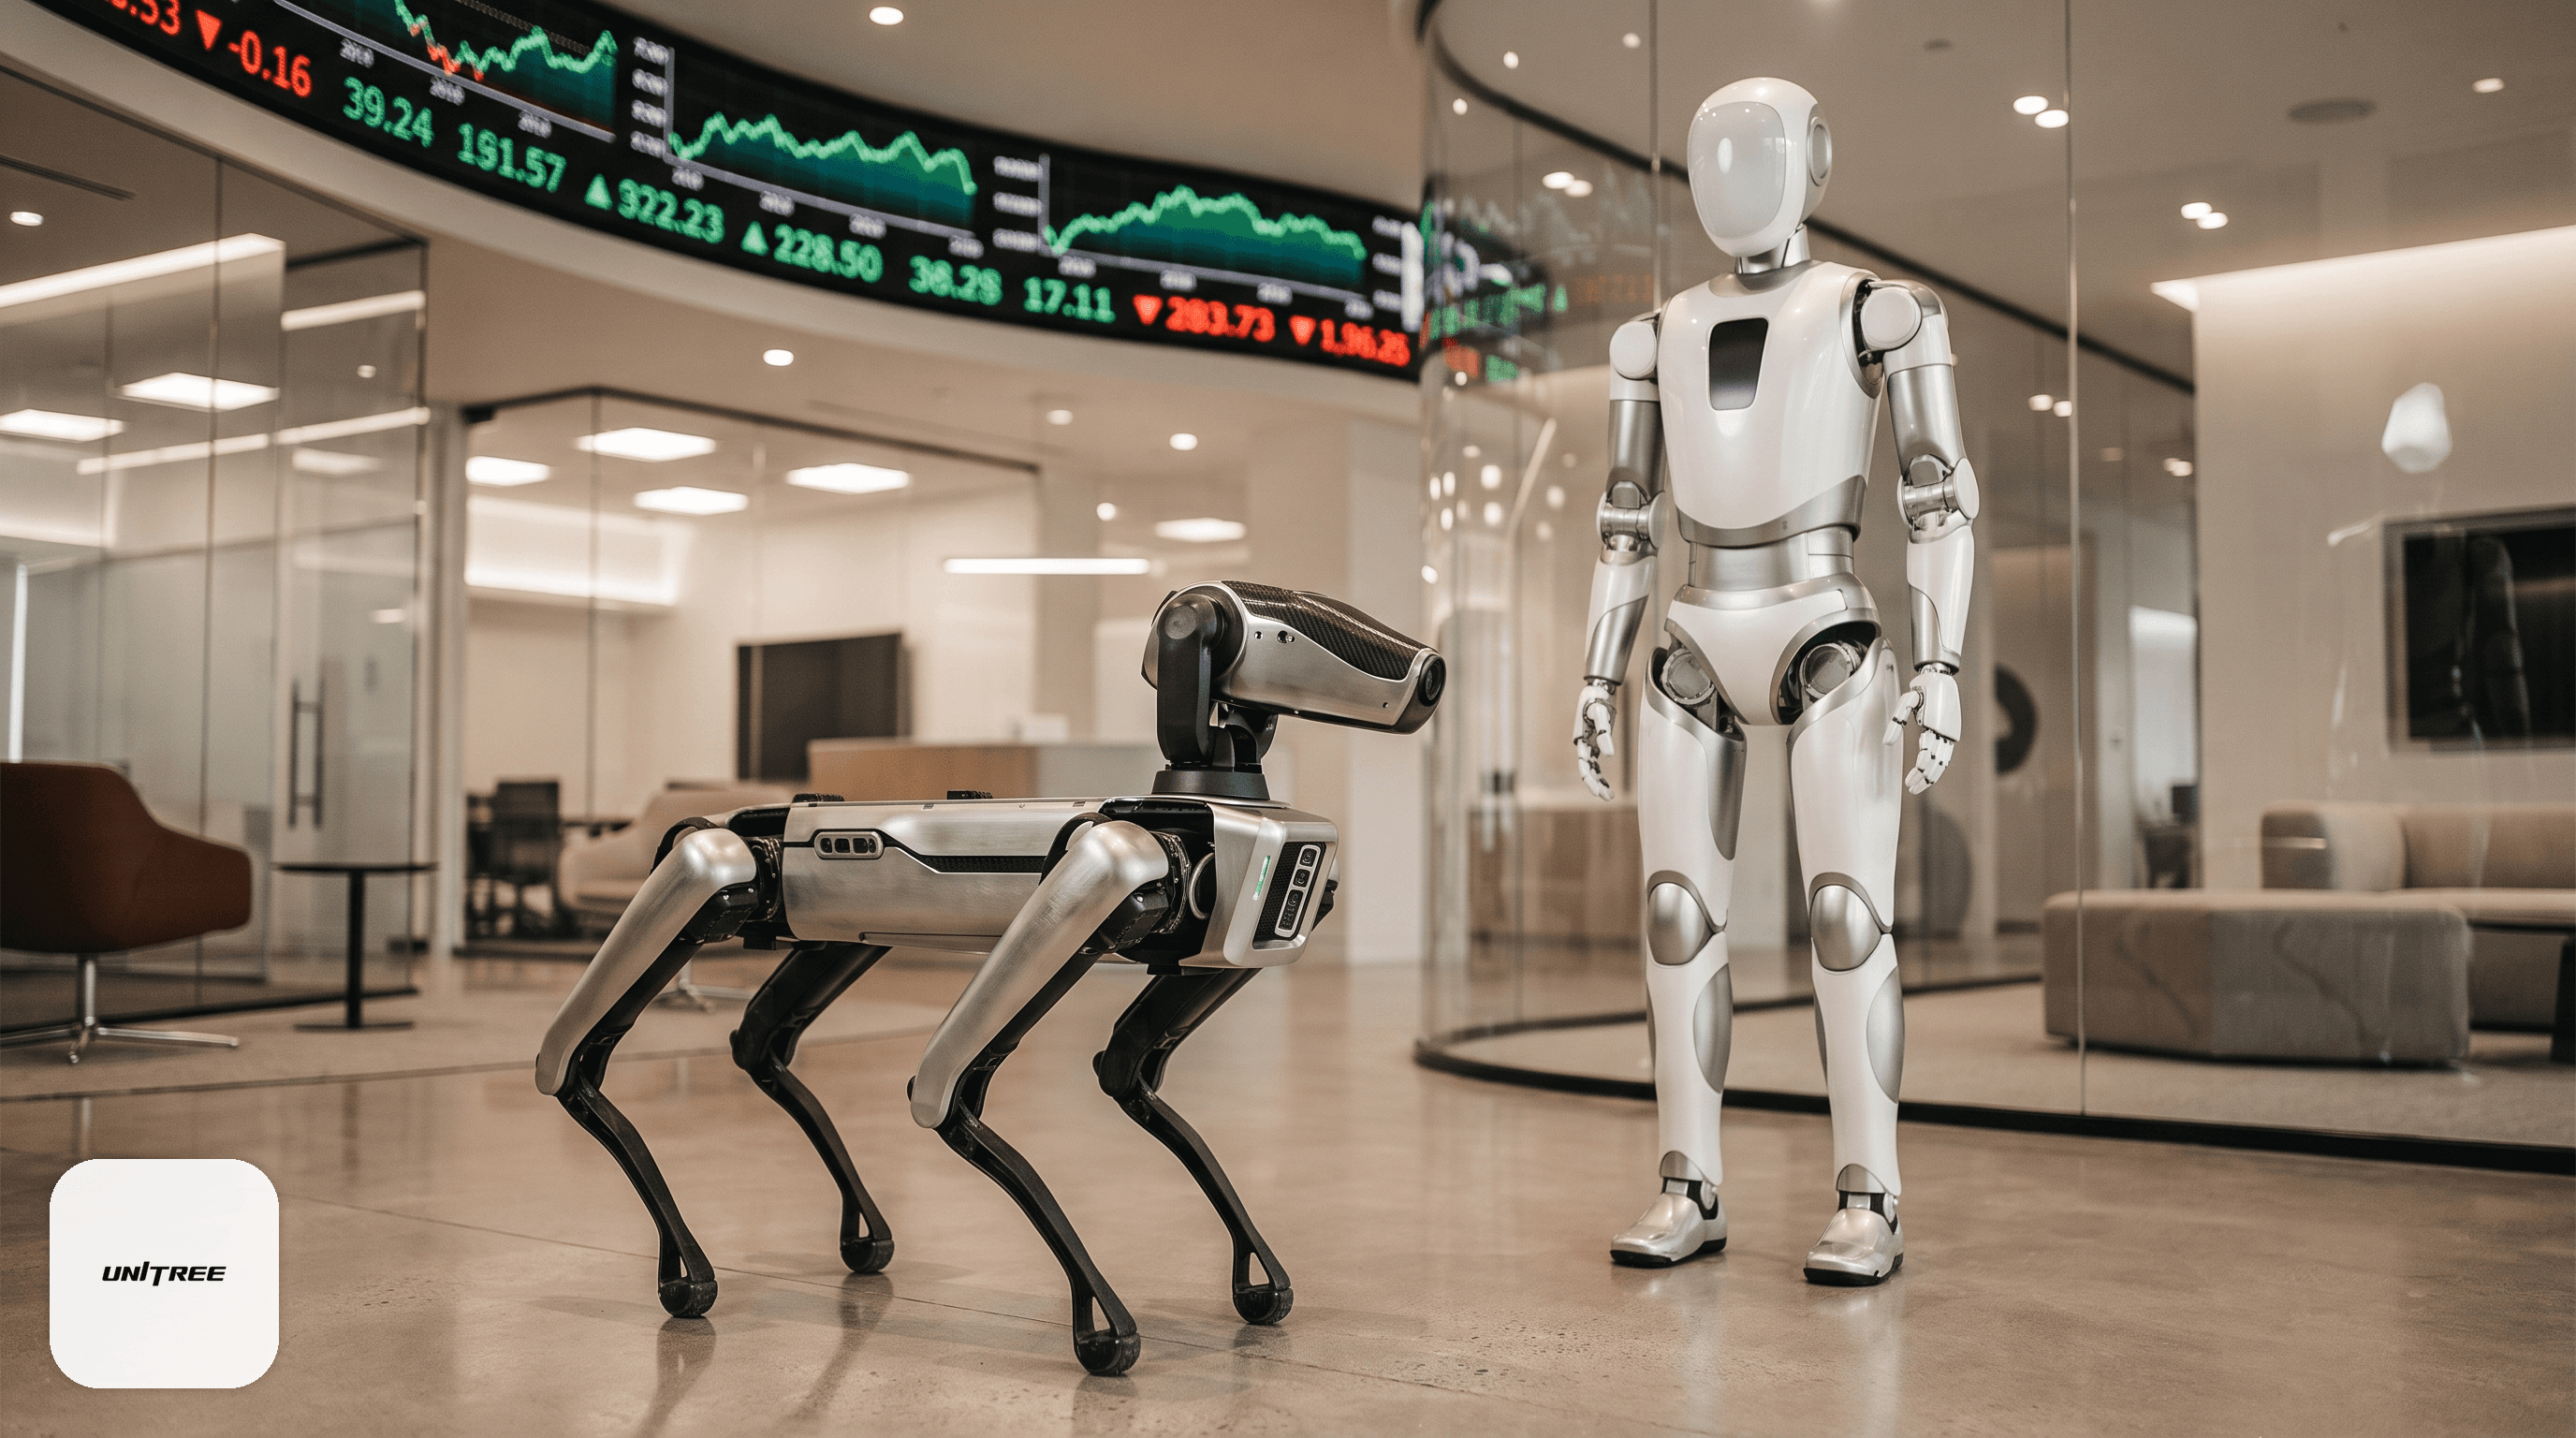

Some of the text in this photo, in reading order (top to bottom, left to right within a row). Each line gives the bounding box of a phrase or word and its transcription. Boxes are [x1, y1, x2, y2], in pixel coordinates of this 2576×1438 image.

[227, 30, 312, 97] -0.16
[343, 76, 435, 148] 39.24
[618, 178, 725, 244] 322.23
[773, 224, 884, 283] 228.50
[1023, 276, 1117, 324] 17.11
